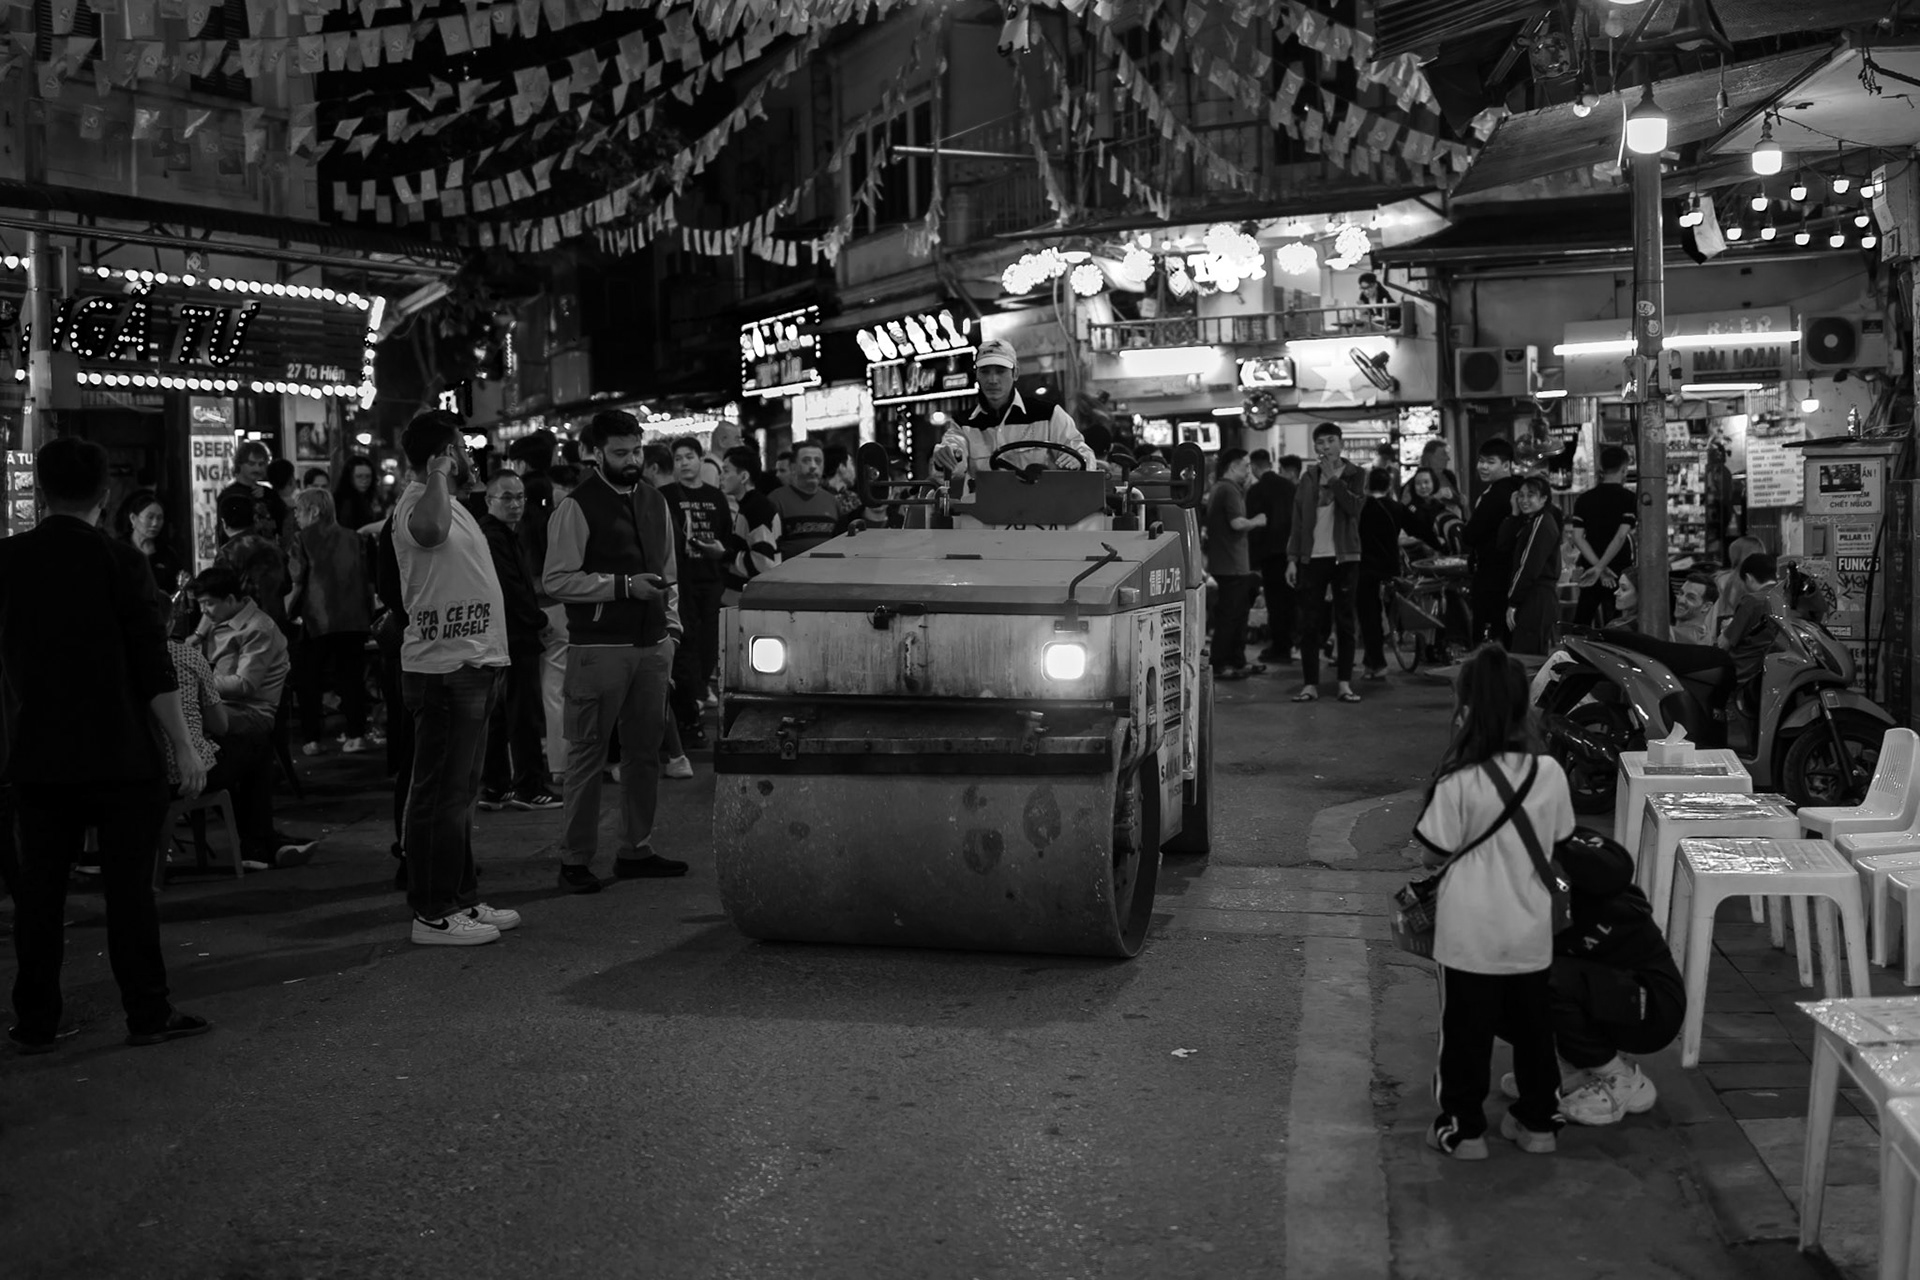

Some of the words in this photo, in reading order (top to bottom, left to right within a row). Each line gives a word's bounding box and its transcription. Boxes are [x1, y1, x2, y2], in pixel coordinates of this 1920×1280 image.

[286, 362, 302, 379] 27
[193, 441, 234, 458] BEER
[1839, 533, 1862, 541] PILLAR
[1863, 533, 1871, 541] 11
[468, 603, 491, 620] FOR
